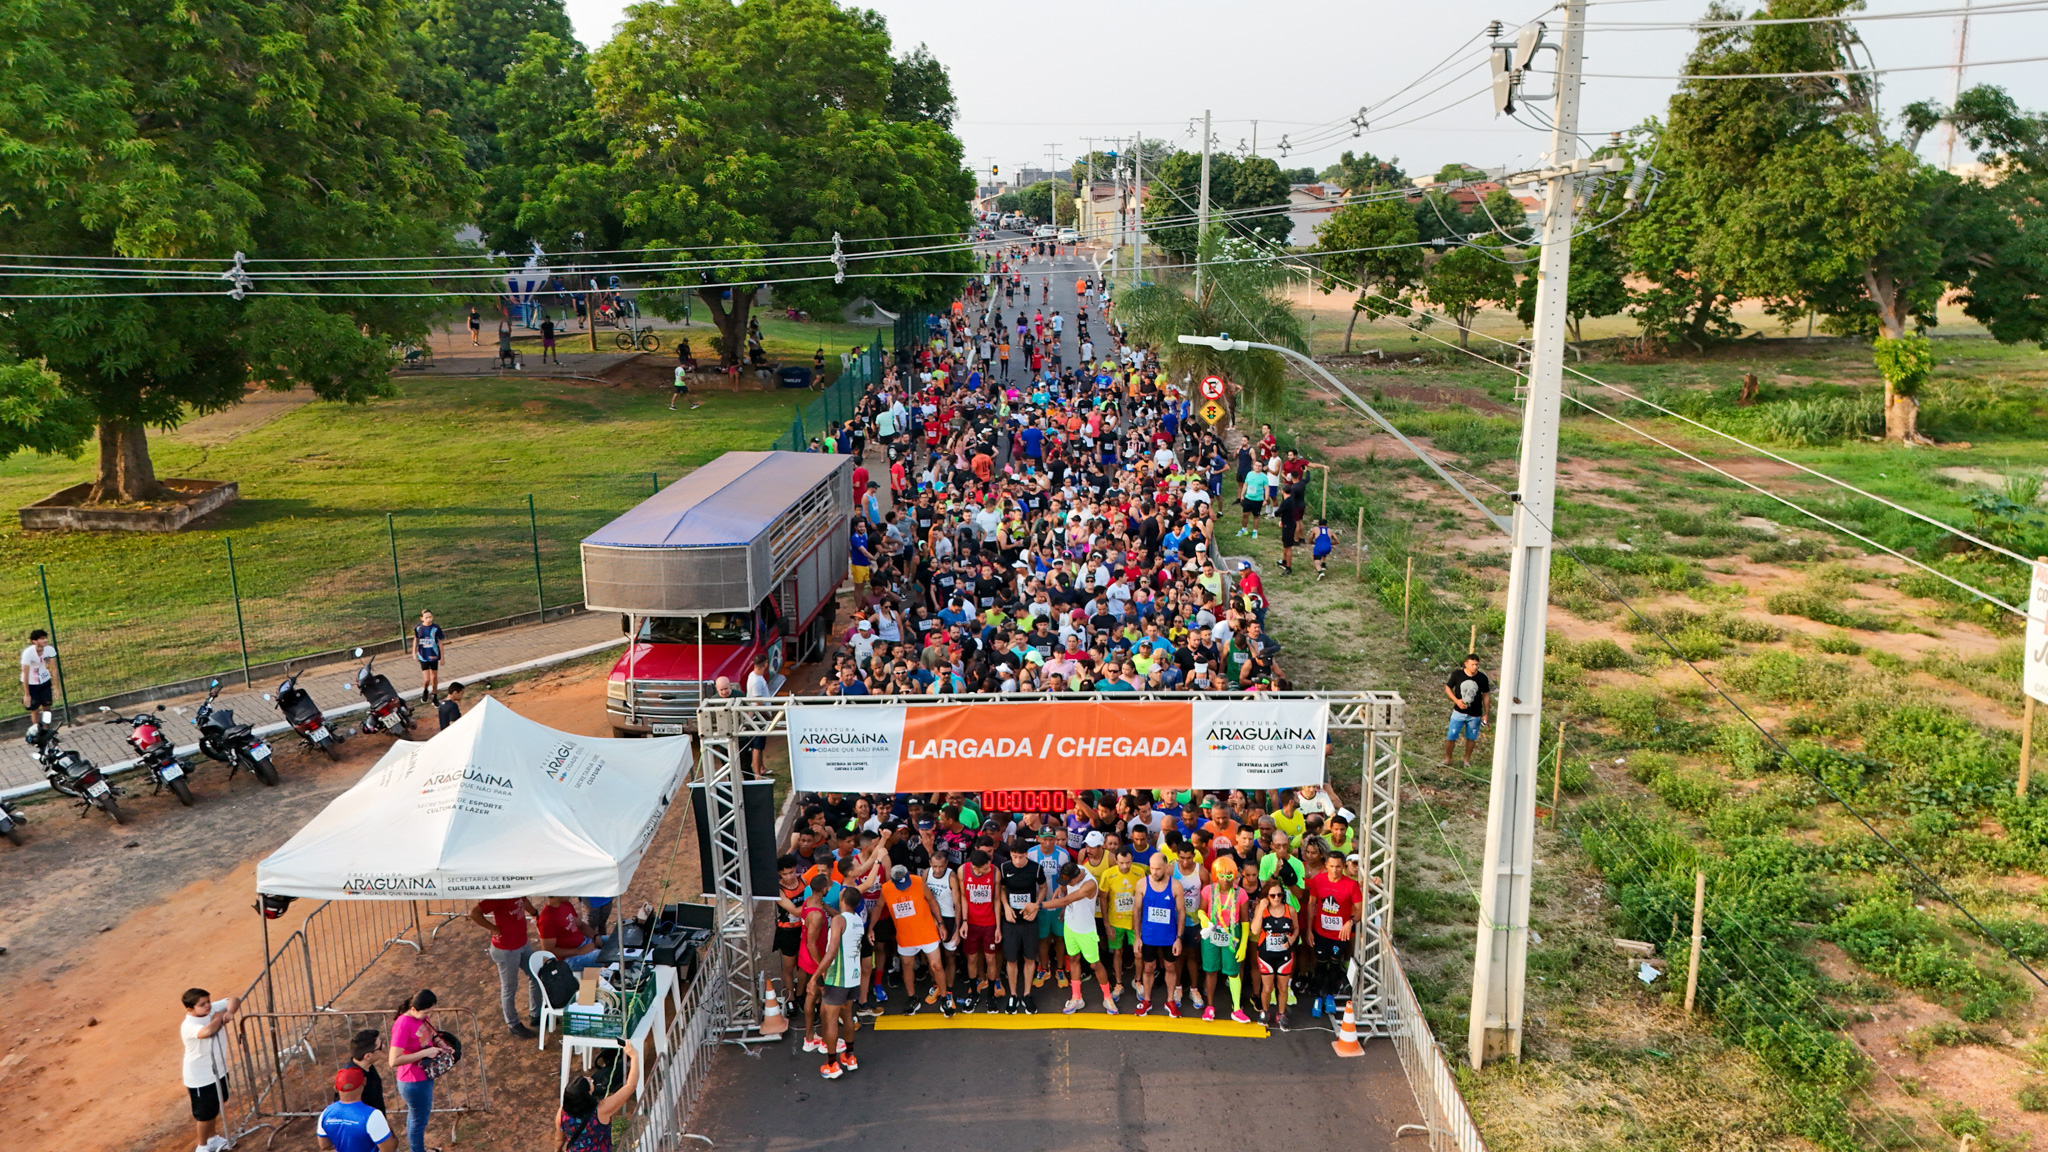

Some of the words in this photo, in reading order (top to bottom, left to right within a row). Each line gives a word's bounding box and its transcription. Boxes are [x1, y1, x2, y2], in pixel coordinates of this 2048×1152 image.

[907, 738, 1033, 760] LARGADA
[1039, 733, 1054, 759] /
[1056, 737, 1187, 757] CHEGADA
[476, 785, 492, 793] NÃO
[493, 788, 512, 796] PARA
[982, 790, 1065, 812] 00:00:00
[465, 805, 489, 815] LAZER
[1042, 860, 1056, 869] 0752
[1013, 895, 1028, 903] 1882
[1118, 898, 1133, 907] 1629
[896, 902, 912, 912] 0591
[1151, 908, 1167, 917] 1651
[1324, 916, 1340, 925] 0363
[1213, 932, 1229, 942] 0755
